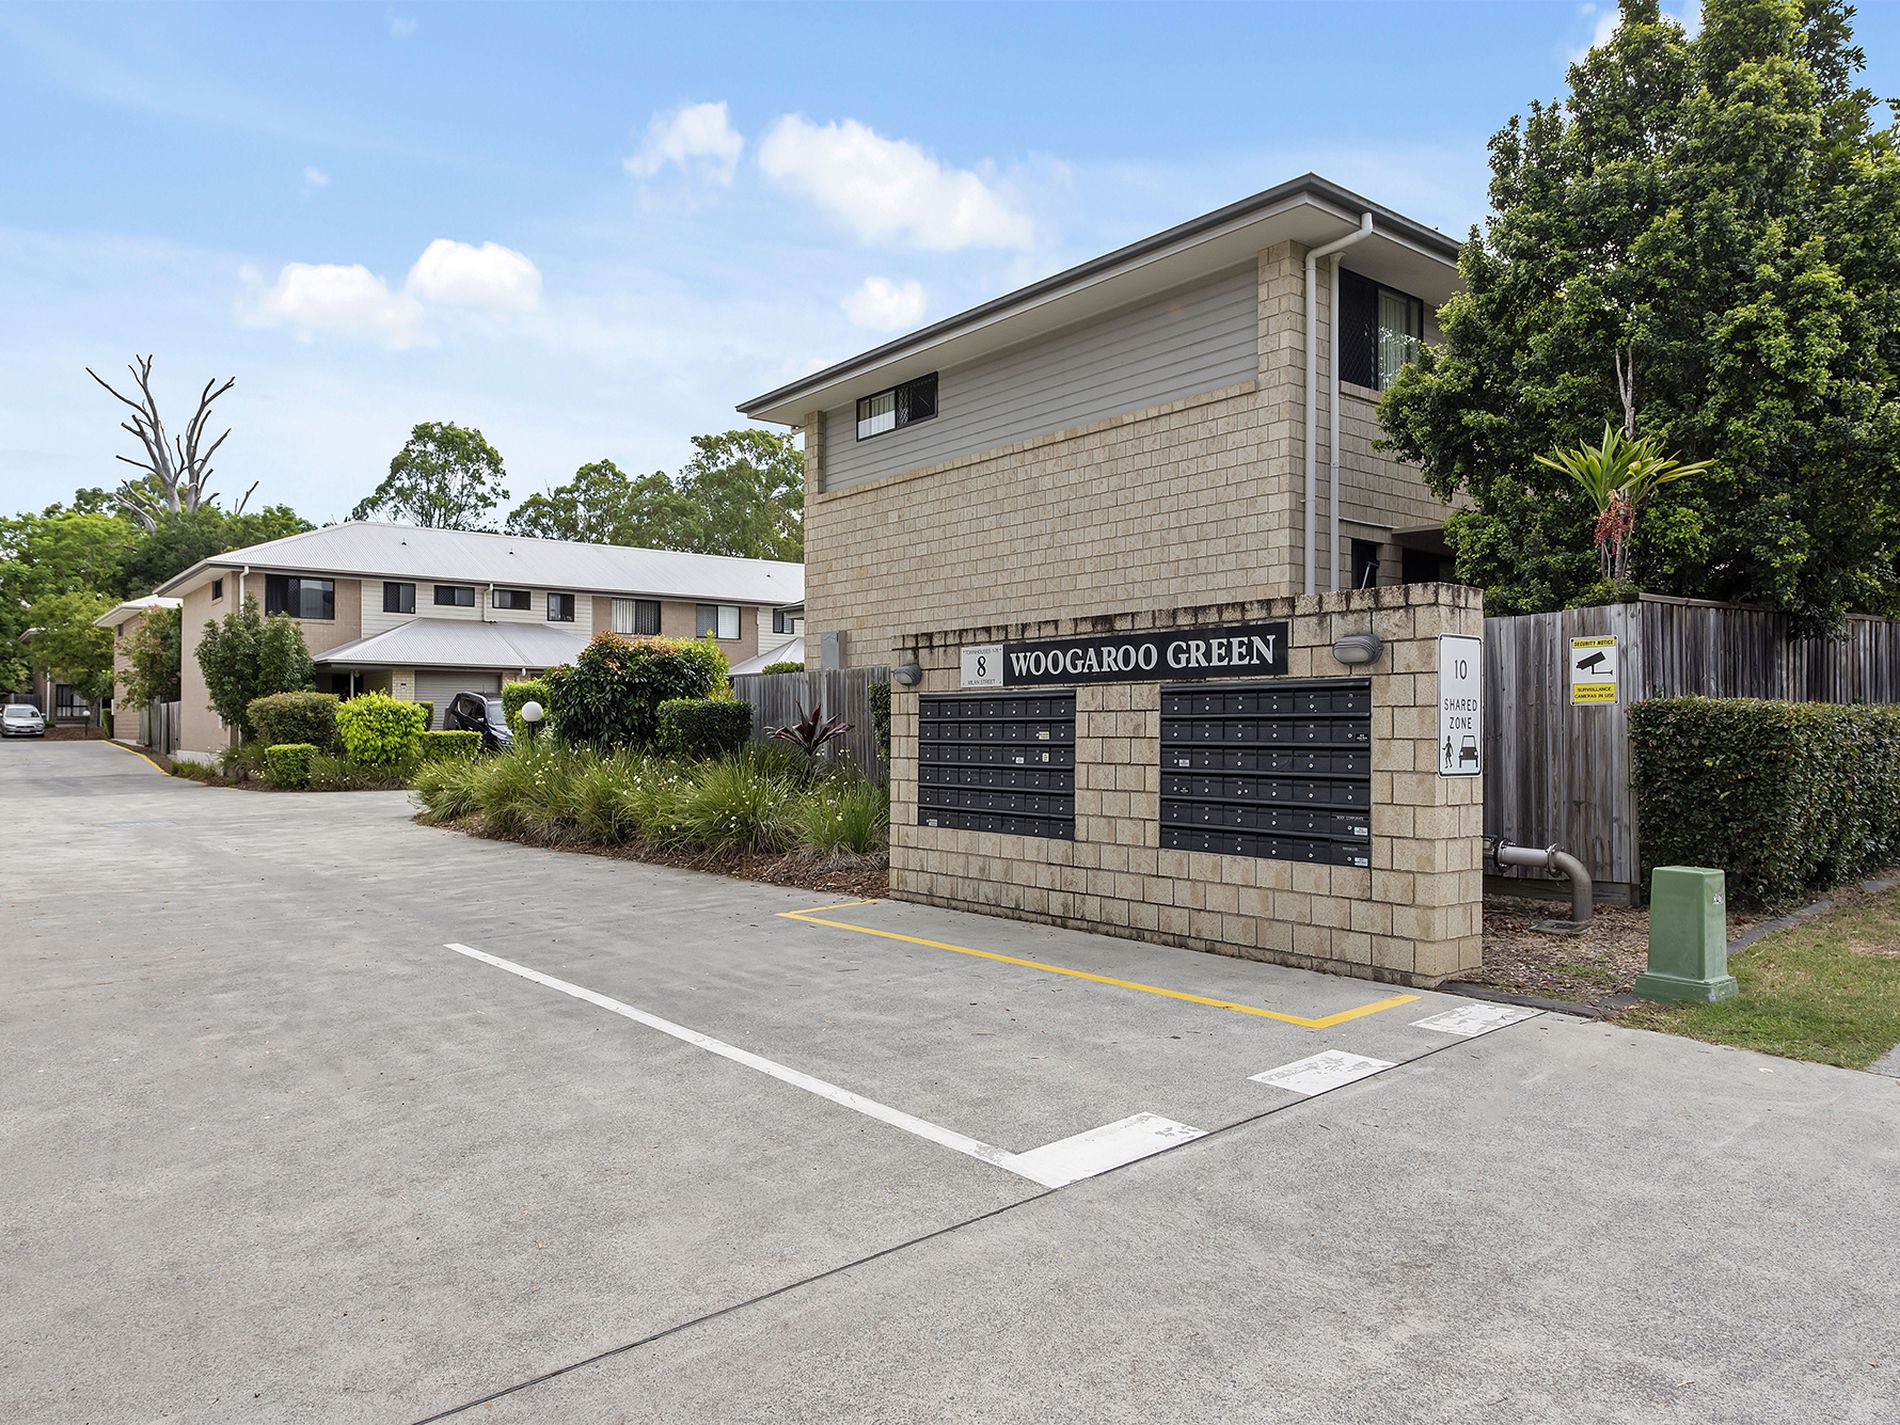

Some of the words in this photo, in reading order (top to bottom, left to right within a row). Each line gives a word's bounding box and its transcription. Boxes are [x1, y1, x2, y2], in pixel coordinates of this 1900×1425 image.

[977, 655, 986, 677] 8
[1010, 643, 1158, 677] WOOGAROO
[1166, 635, 1276, 669] GREEN
[1454, 659, 1468, 680] 10
[1443, 698, 1478, 712] SHARED
[1449, 716, 1472, 730] ZONE
